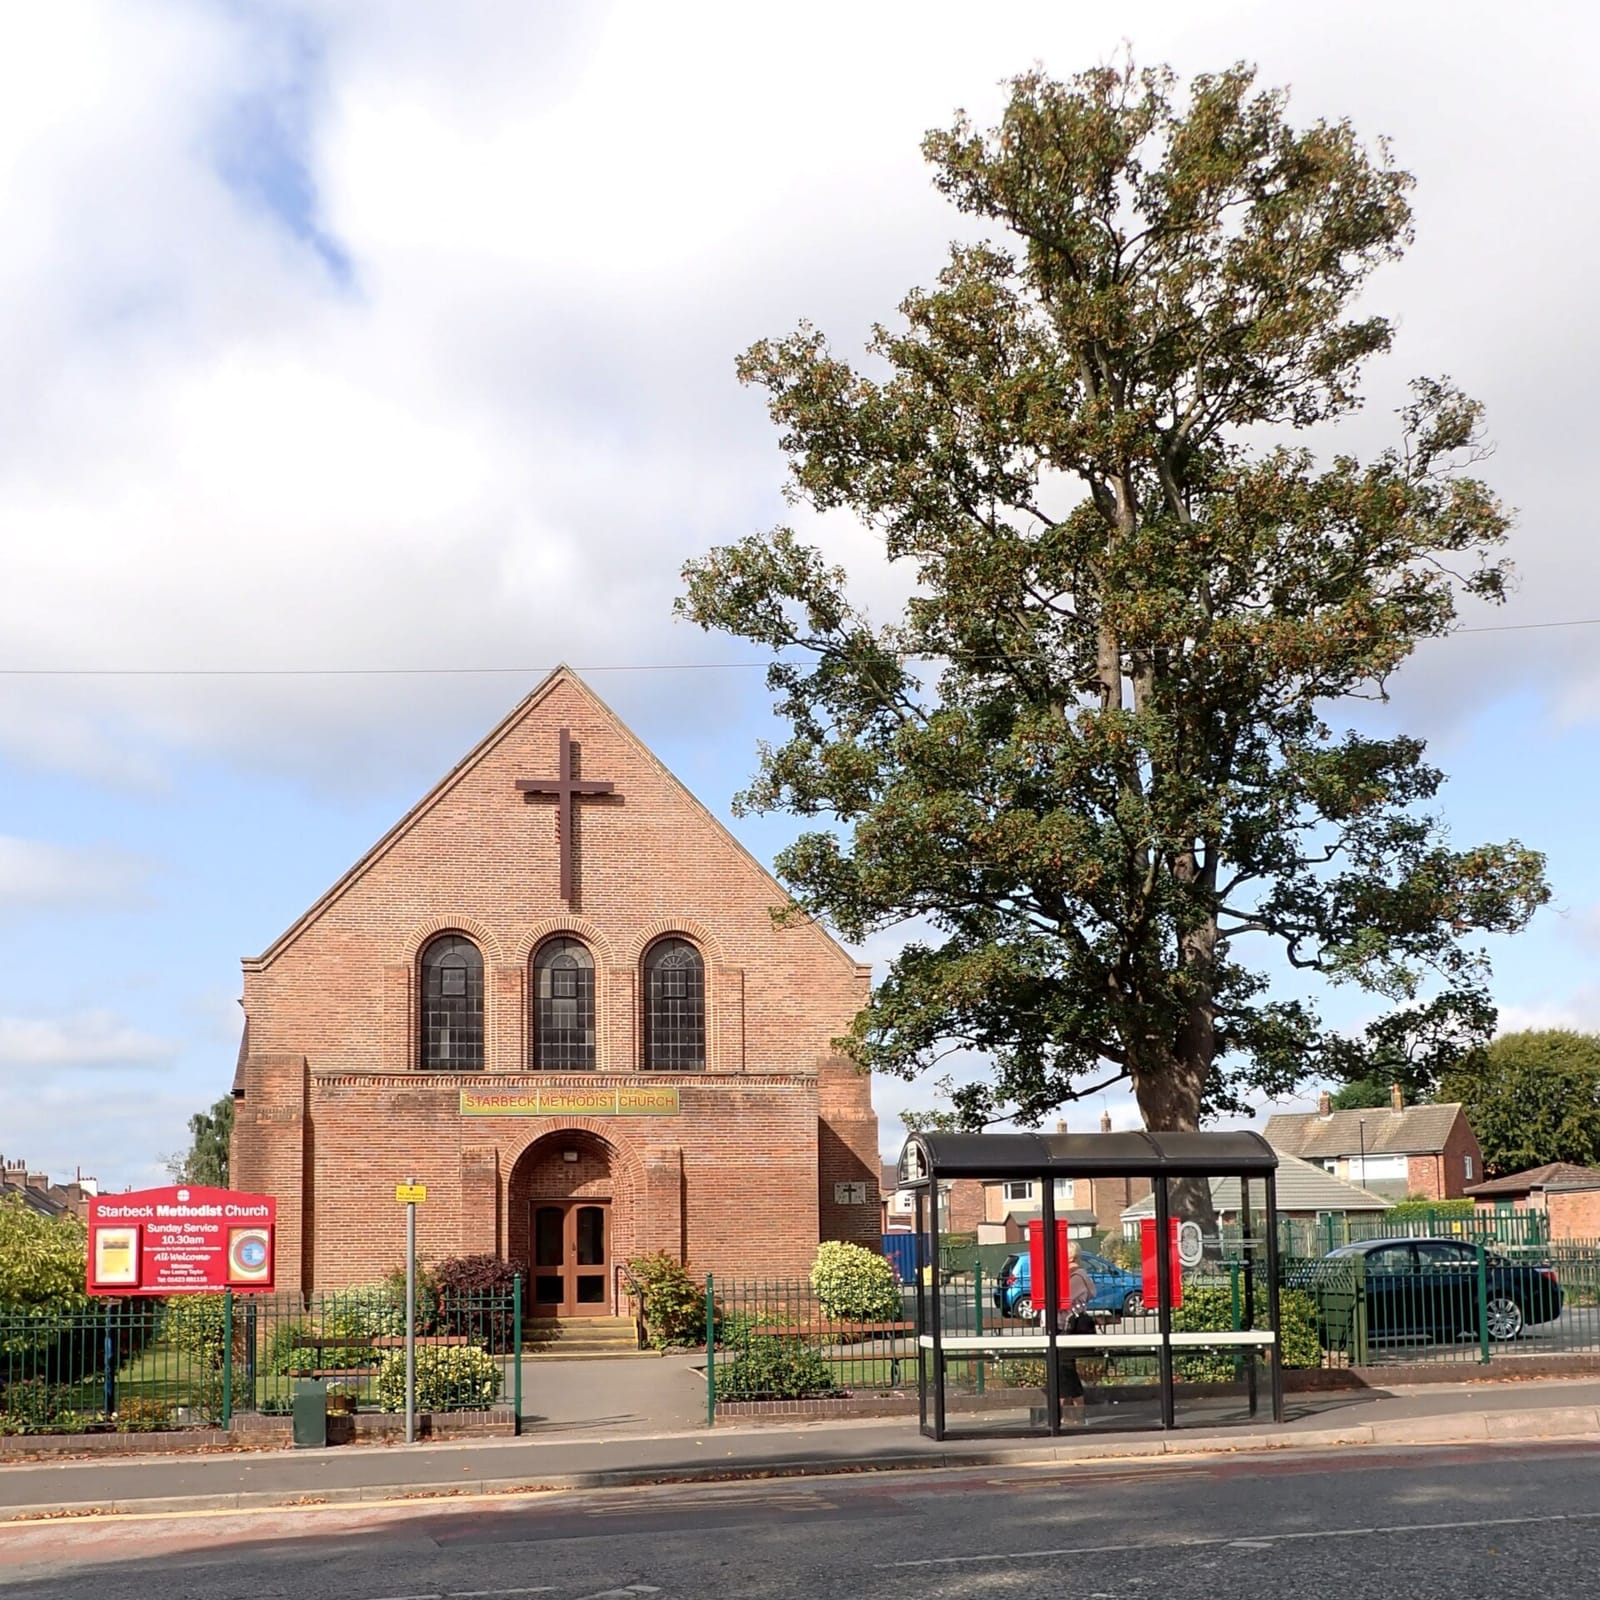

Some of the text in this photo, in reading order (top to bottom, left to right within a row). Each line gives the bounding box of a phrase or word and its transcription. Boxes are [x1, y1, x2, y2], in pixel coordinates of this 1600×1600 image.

[466, 1096, 674, 1107] STARBECK METHODIST CHURCH
[97, 1204, 269, 1217] Starbeck Methodist Church
[147, 1222, 219, 1234] Sunday Service
[161, 1235, 204, 1245] 10.30am
[154, 1252, 211, 1261] All Welcome
